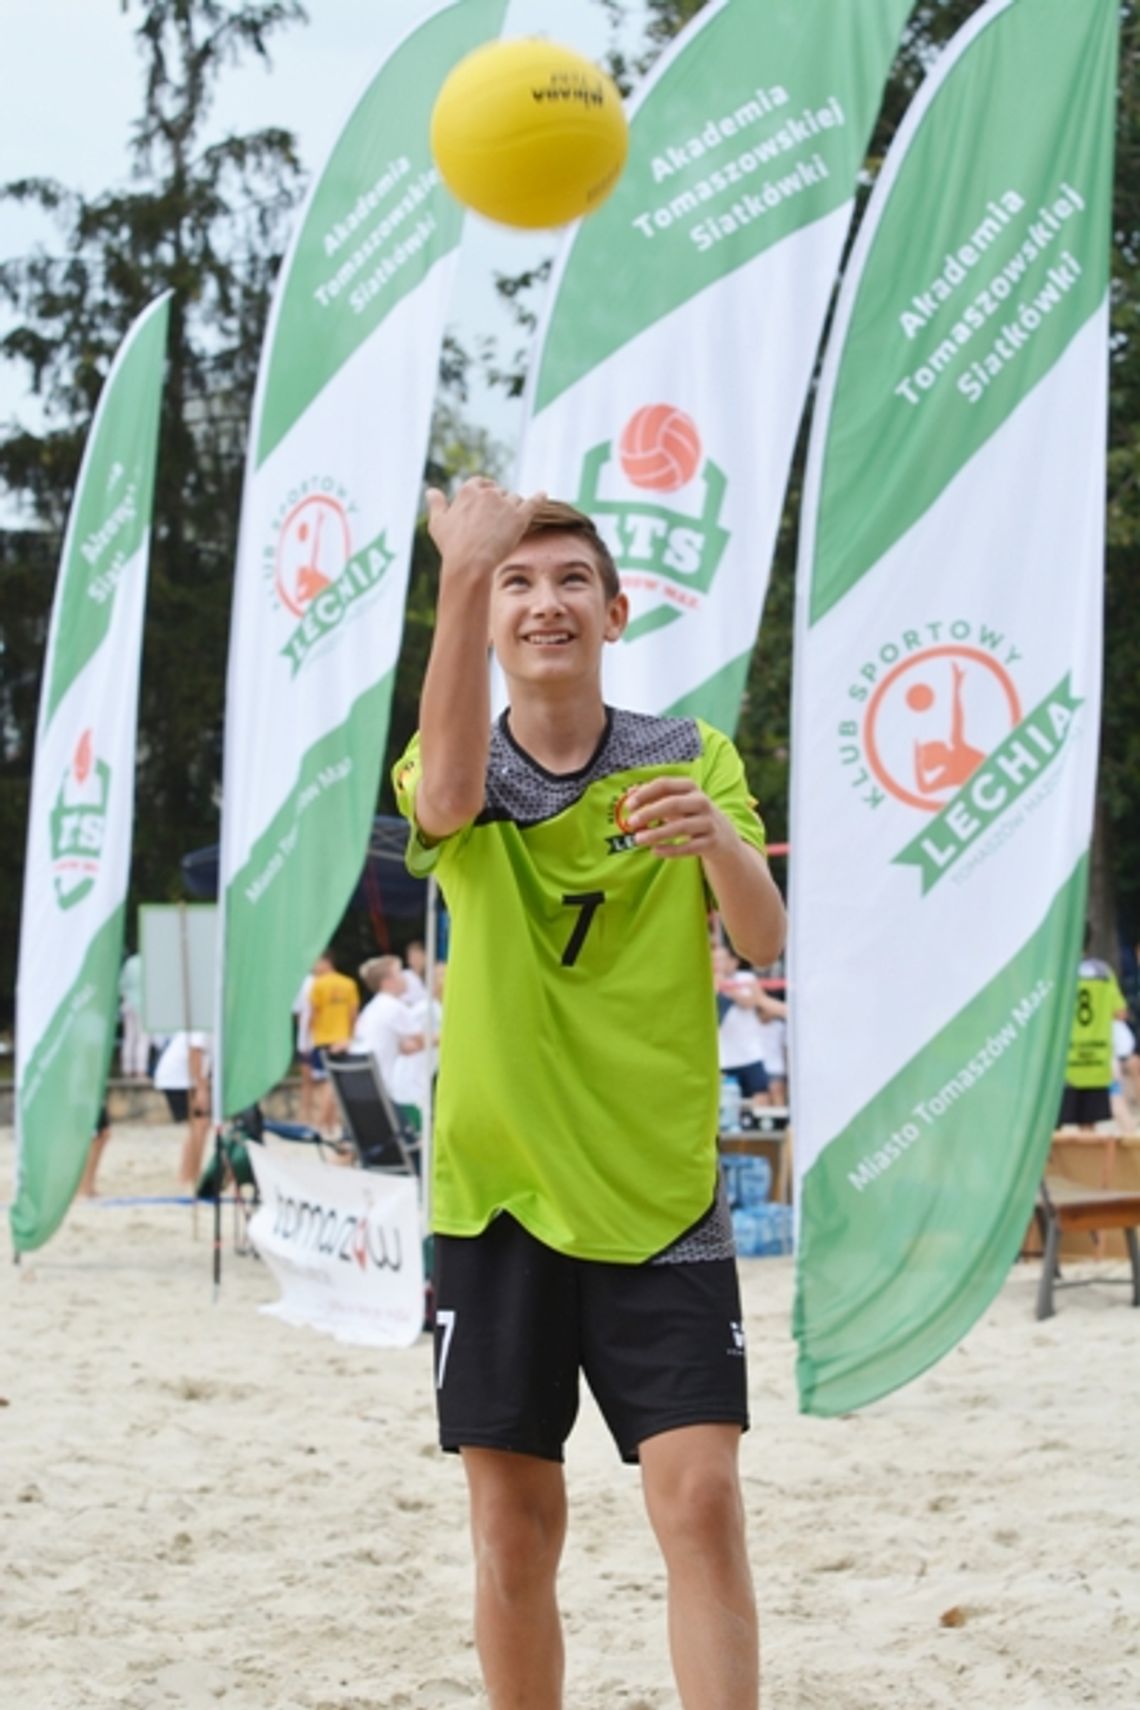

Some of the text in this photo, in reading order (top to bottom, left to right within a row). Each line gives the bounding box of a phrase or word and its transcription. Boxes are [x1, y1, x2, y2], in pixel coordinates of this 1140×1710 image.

[632, 96, 845, 238] Tomaszowskiej
[650, 84, 789, 183] Akademia
[322, 156, 410, 257] Akademia
[689, 154, 829, 251] Siatkówki
[900, 190, 1025, 338] Akademia
[895, 183, 1085, 404] Tomaszowskiej
[957, 251, 1081, 403] Siatkówki
[290, 547, 388, 656] LECHIA
[838, 619, 1022, 810] KLUB SPORTOWY
[920, 701, 1073, 868] LECHIA
[562, 890, 606, 967] 7
[1077, 988, 1094, 1027] 8
[847, 1123, 920, 1192] Miasto
[912, 1023, 1018, 1124] Tomaszów
[436, 1310, 456, 1390] 7
